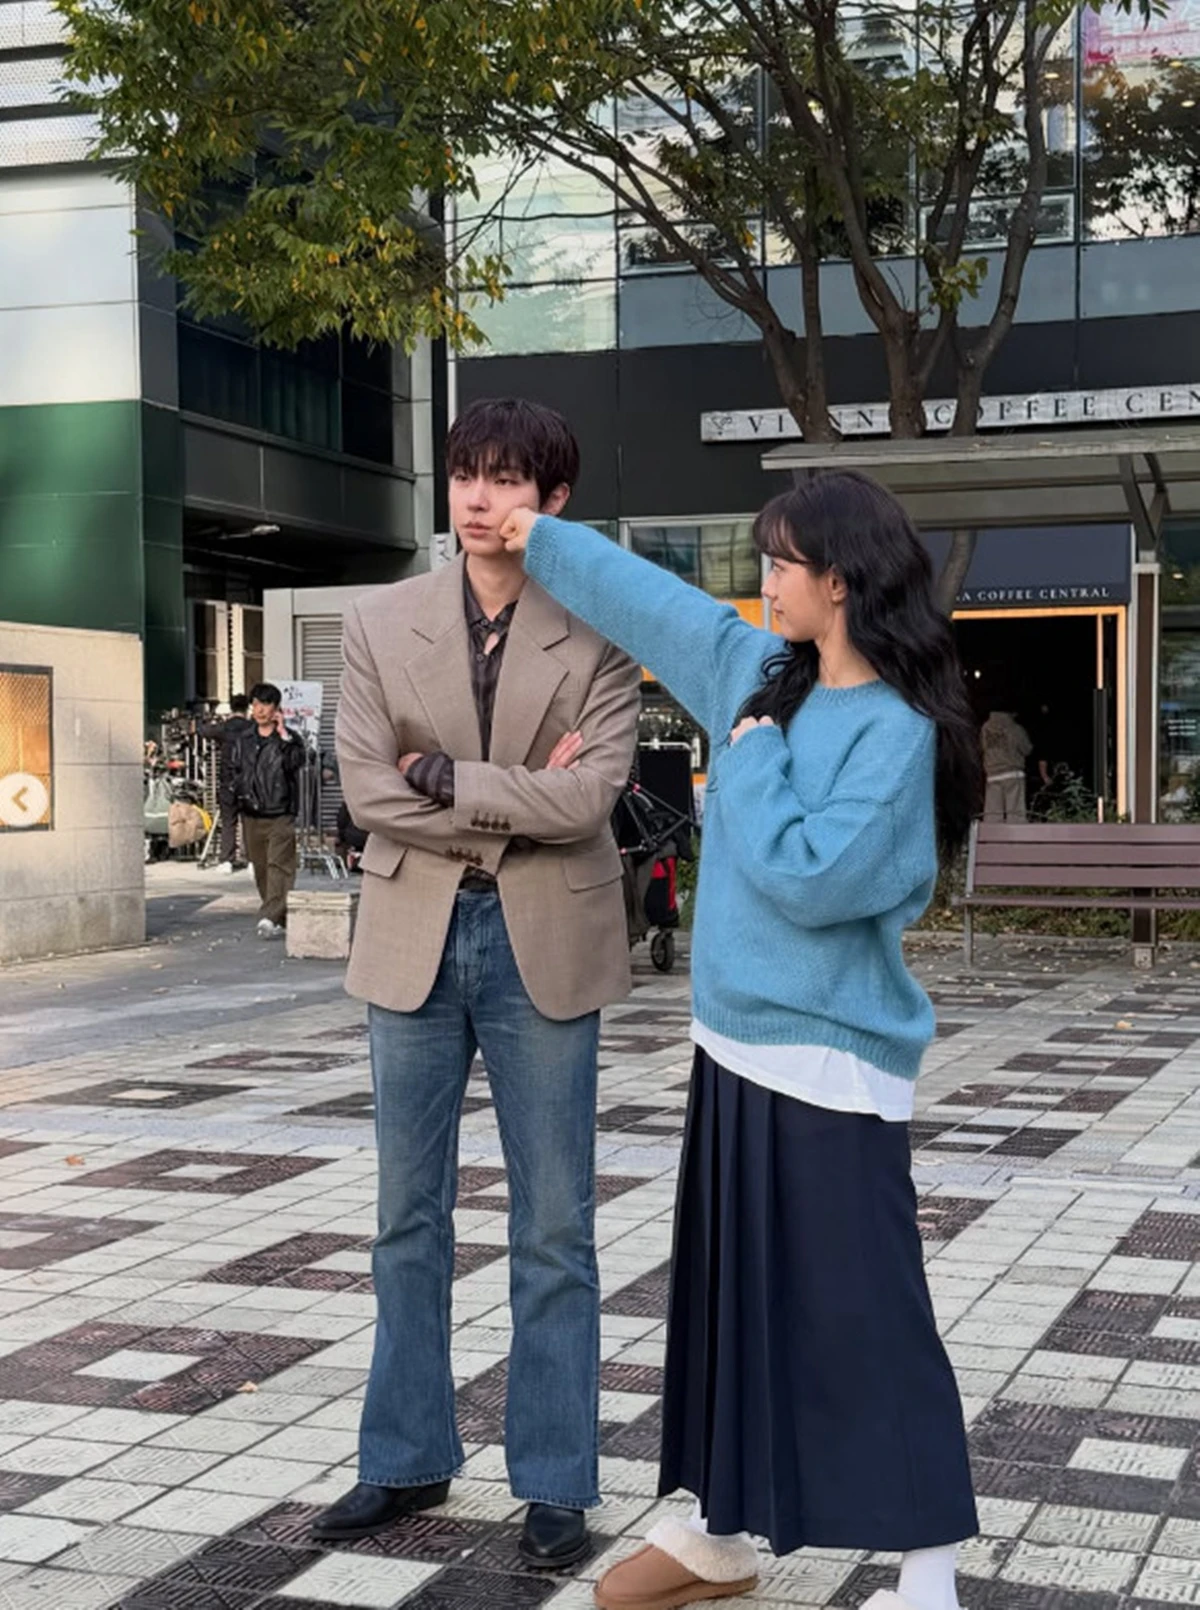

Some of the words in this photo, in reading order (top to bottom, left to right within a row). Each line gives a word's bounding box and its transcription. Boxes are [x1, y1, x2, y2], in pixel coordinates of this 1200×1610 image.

[748, 409, 874, 433] VINN
[977, 589, 1032, 601] COFFEE
[1039, 587, 1109, 600] CENTRAL
